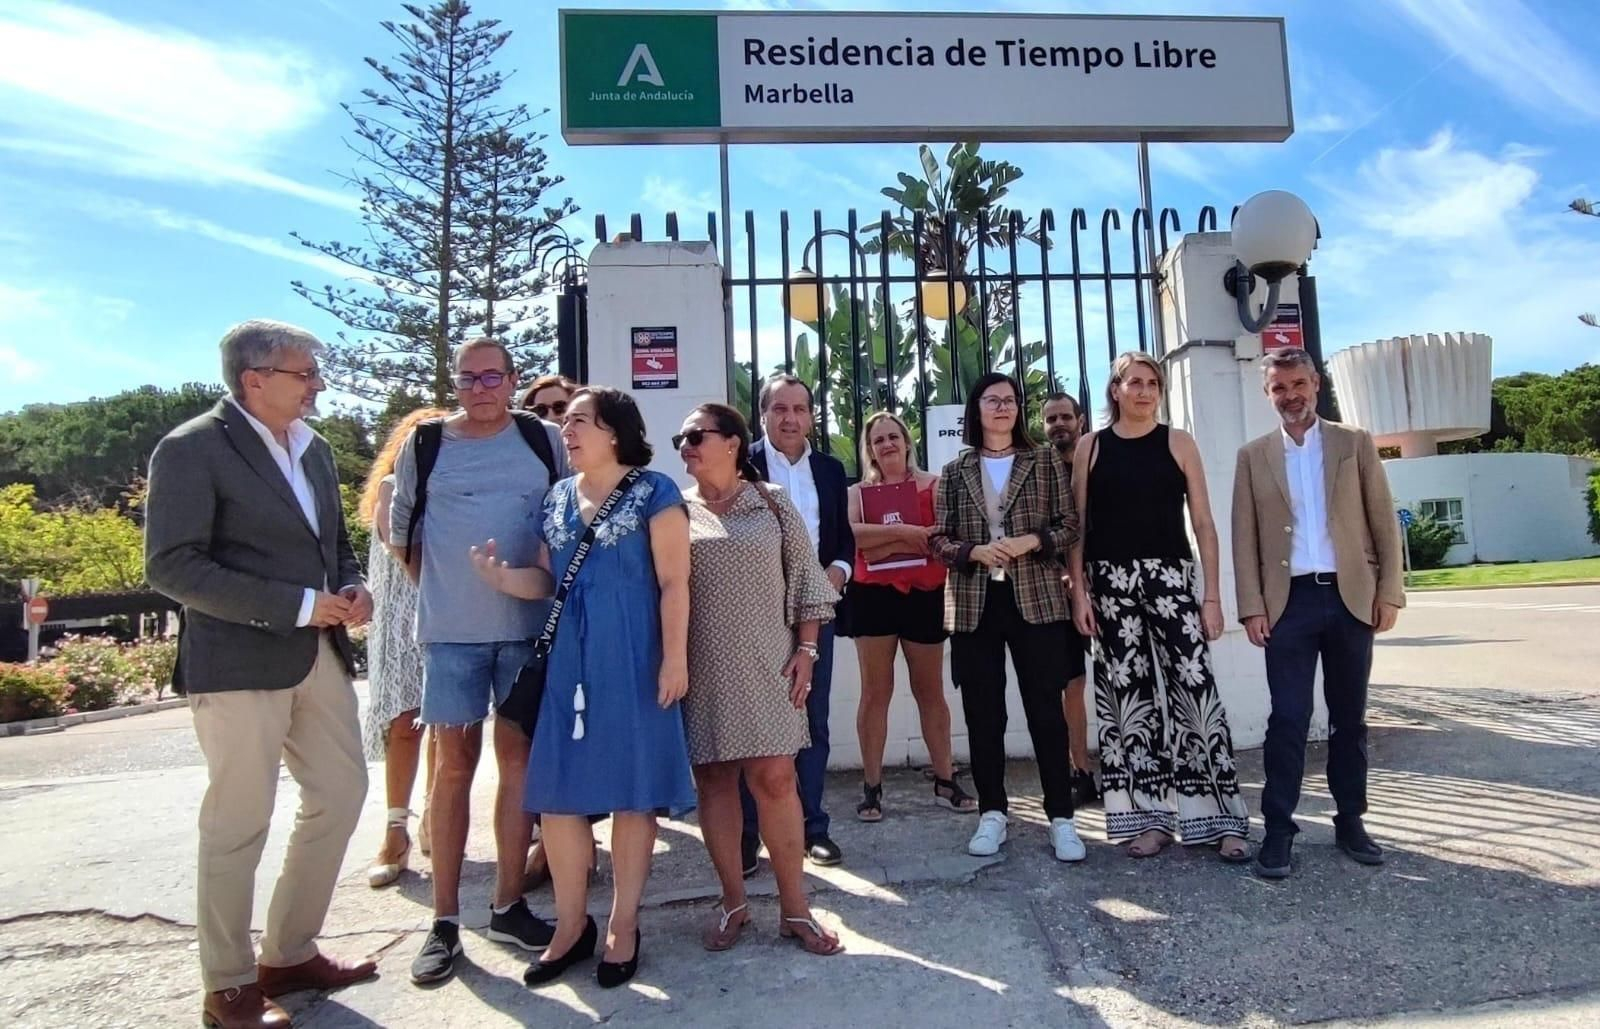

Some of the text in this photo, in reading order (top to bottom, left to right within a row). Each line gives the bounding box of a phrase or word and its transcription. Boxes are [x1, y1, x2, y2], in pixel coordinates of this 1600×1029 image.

[744, 37, 1217, 74] Residencia de Tiempo Libre
[589, 90, 694, 101] Junta de Andalucía
[744, 83, 854, 104] Marbella
[938, 429, 965, 438] PRO
